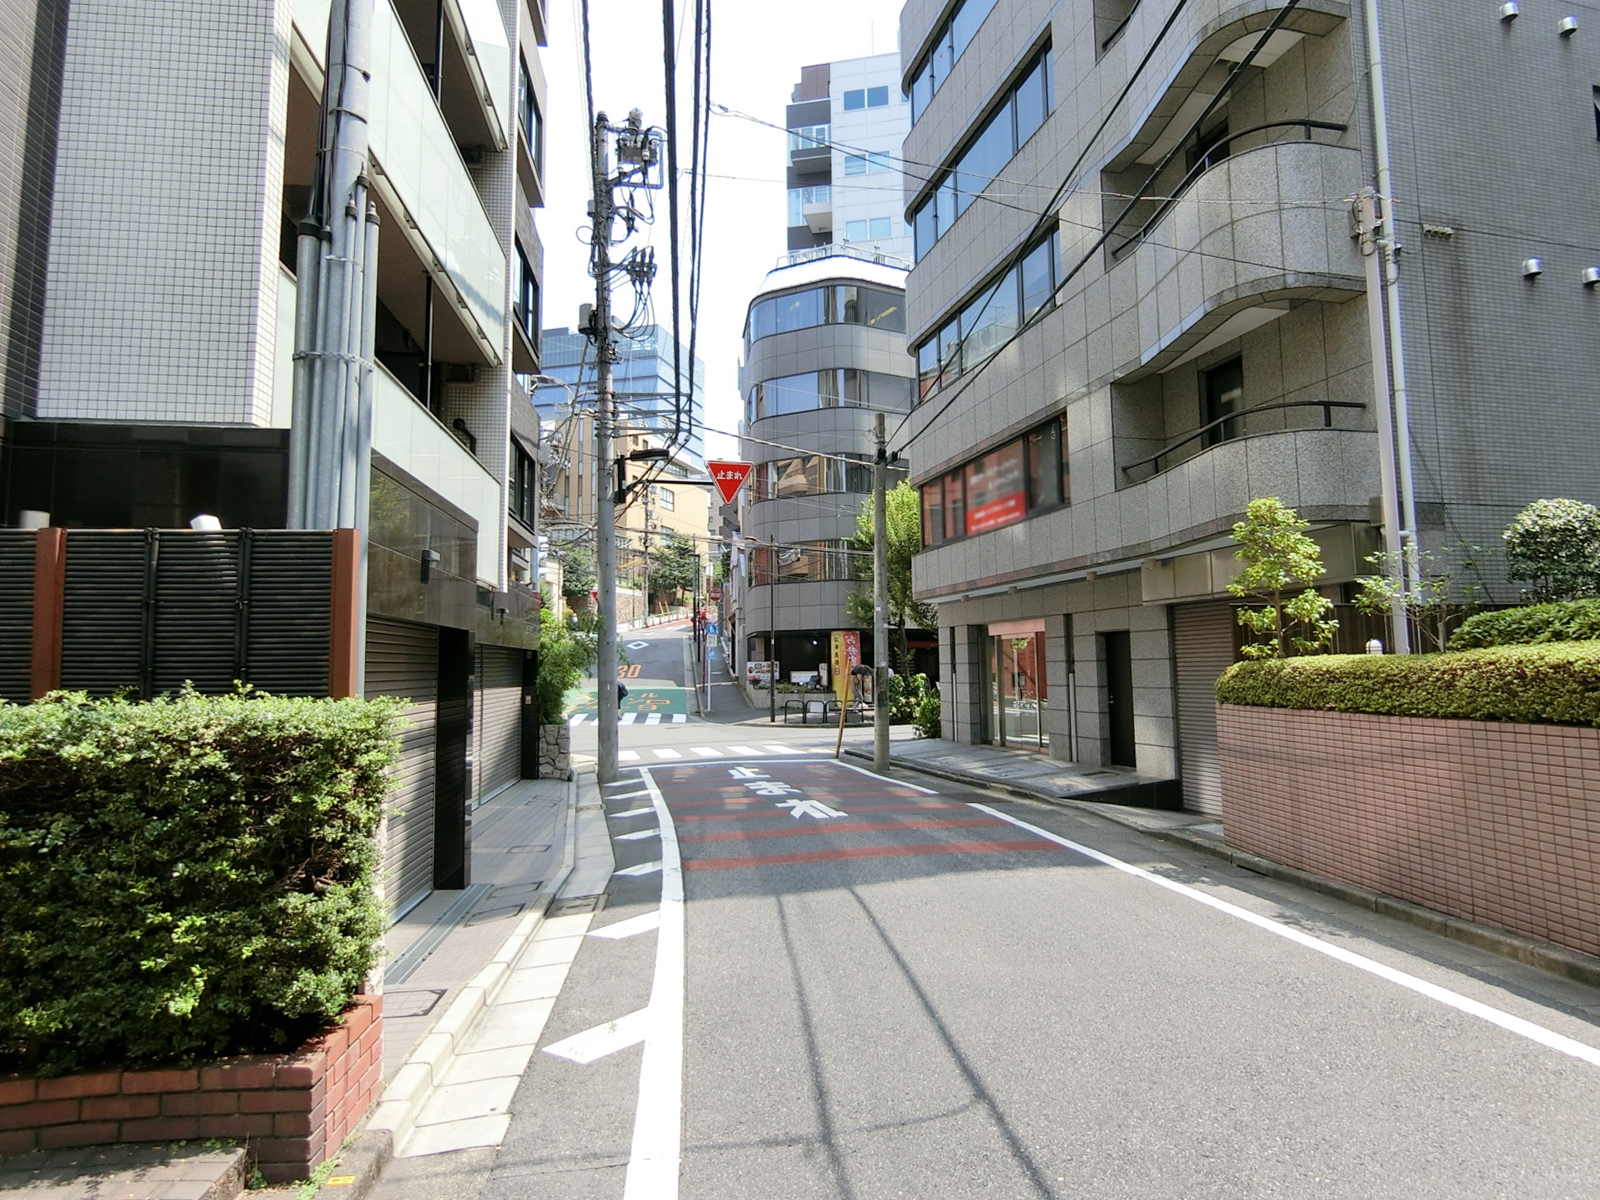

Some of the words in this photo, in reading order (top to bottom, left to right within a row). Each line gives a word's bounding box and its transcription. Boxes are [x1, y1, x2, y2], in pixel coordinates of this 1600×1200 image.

[717, 470, 743, 480] 止まれ
[617, 664, 641, 678] 30
[728, 766, 848, 819] 止まれ
